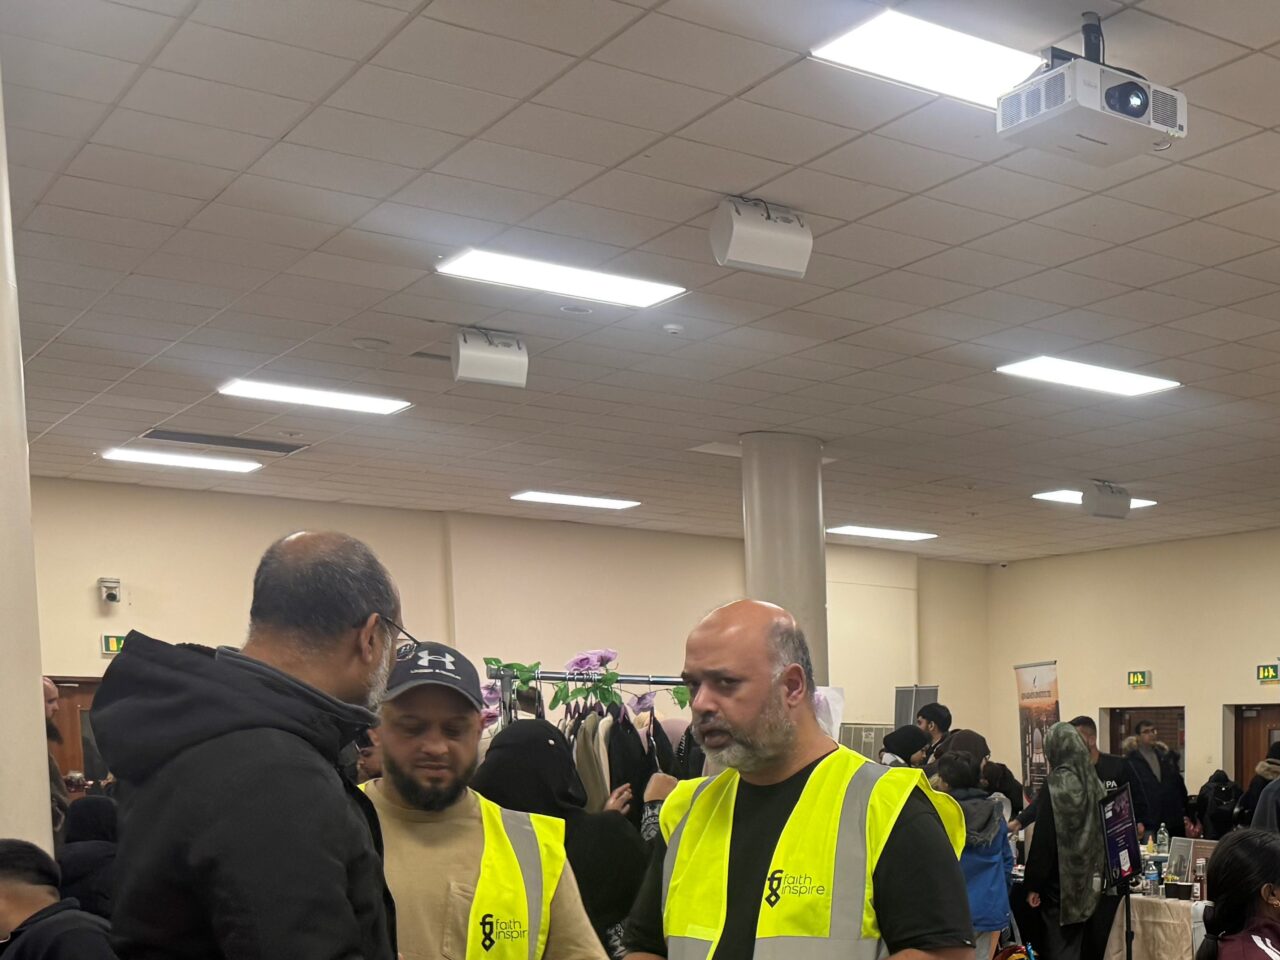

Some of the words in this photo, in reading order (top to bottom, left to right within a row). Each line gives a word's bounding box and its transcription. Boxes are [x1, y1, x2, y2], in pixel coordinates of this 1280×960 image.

[783, 873, 813, 885] faith
[781, 884, 826, 897] inspire
[495, 918, 522, 930] faith
[496, 929, 528, 942] inspir
